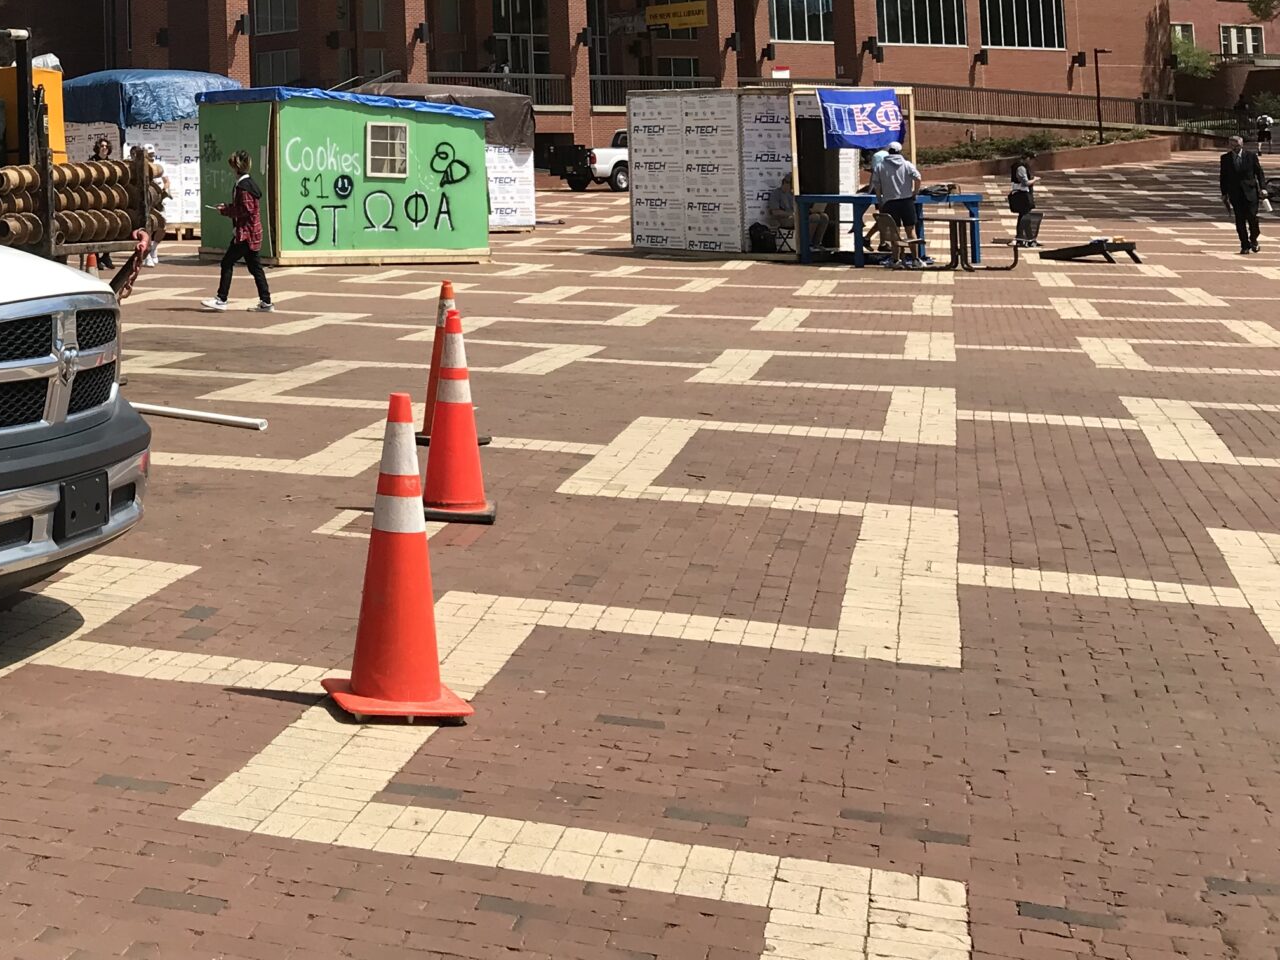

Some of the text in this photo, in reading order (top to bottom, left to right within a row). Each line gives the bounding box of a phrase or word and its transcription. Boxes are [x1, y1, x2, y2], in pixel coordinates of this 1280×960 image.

[183, 123, 199, 131] R-T
[633, 125, 665, 134] R-TECH
[685, 125, 718, 135] R-TECH
[285, 136, 361, 176] Cookies
[755, 153, 792, 163] R-TECH
[634, 161, 666, 171] R-TECH
[686, 164, 719, 173] R-TECH
[300, 173, 329, 199] $1
[635, 198, 667, 208] R-TECH
[687, 202, 721, 211] R-TECH
[636, 234, 668, 244] R-TECH
[688, 240, 722, 250] R-TECH
